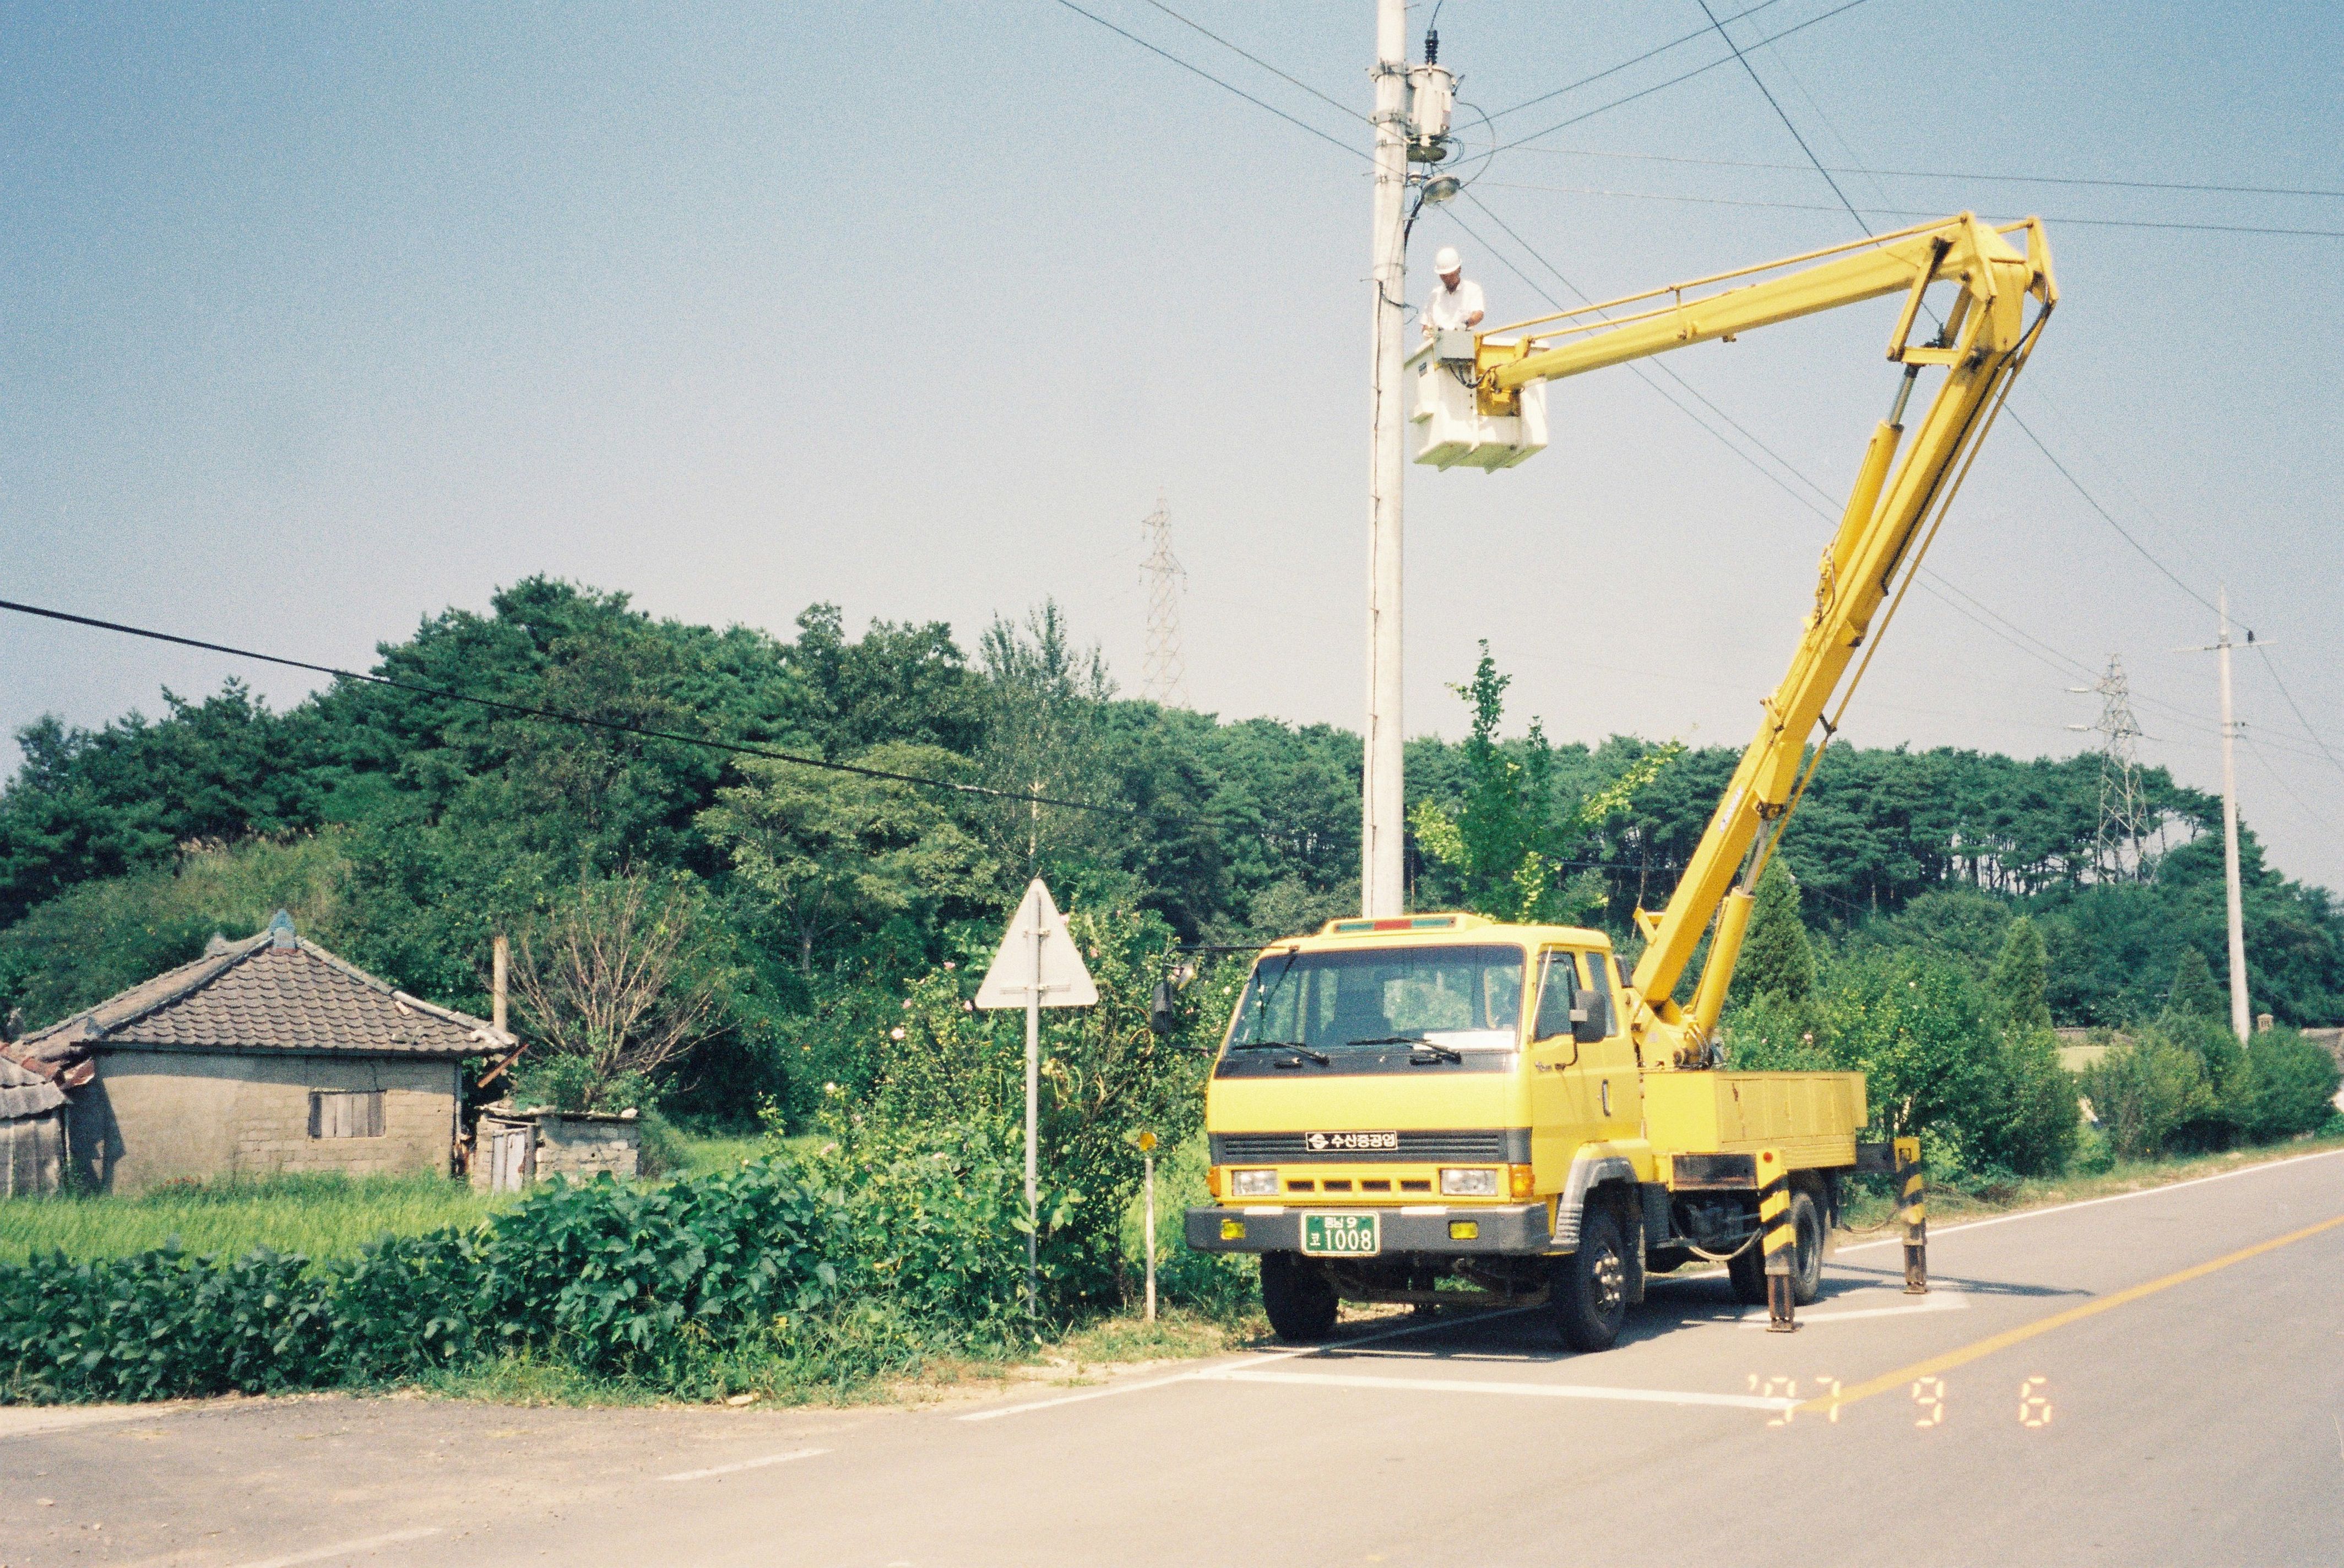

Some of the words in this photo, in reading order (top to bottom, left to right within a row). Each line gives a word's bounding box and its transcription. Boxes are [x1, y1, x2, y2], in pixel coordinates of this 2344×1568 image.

[1331, 1133, 1395, 1148] 수산중공업
[1347, 1217, 1357, 1228] 9
[1310, 1232, 1321, 1246] 코
[1326, 1229, 1372, 1250] 1008
